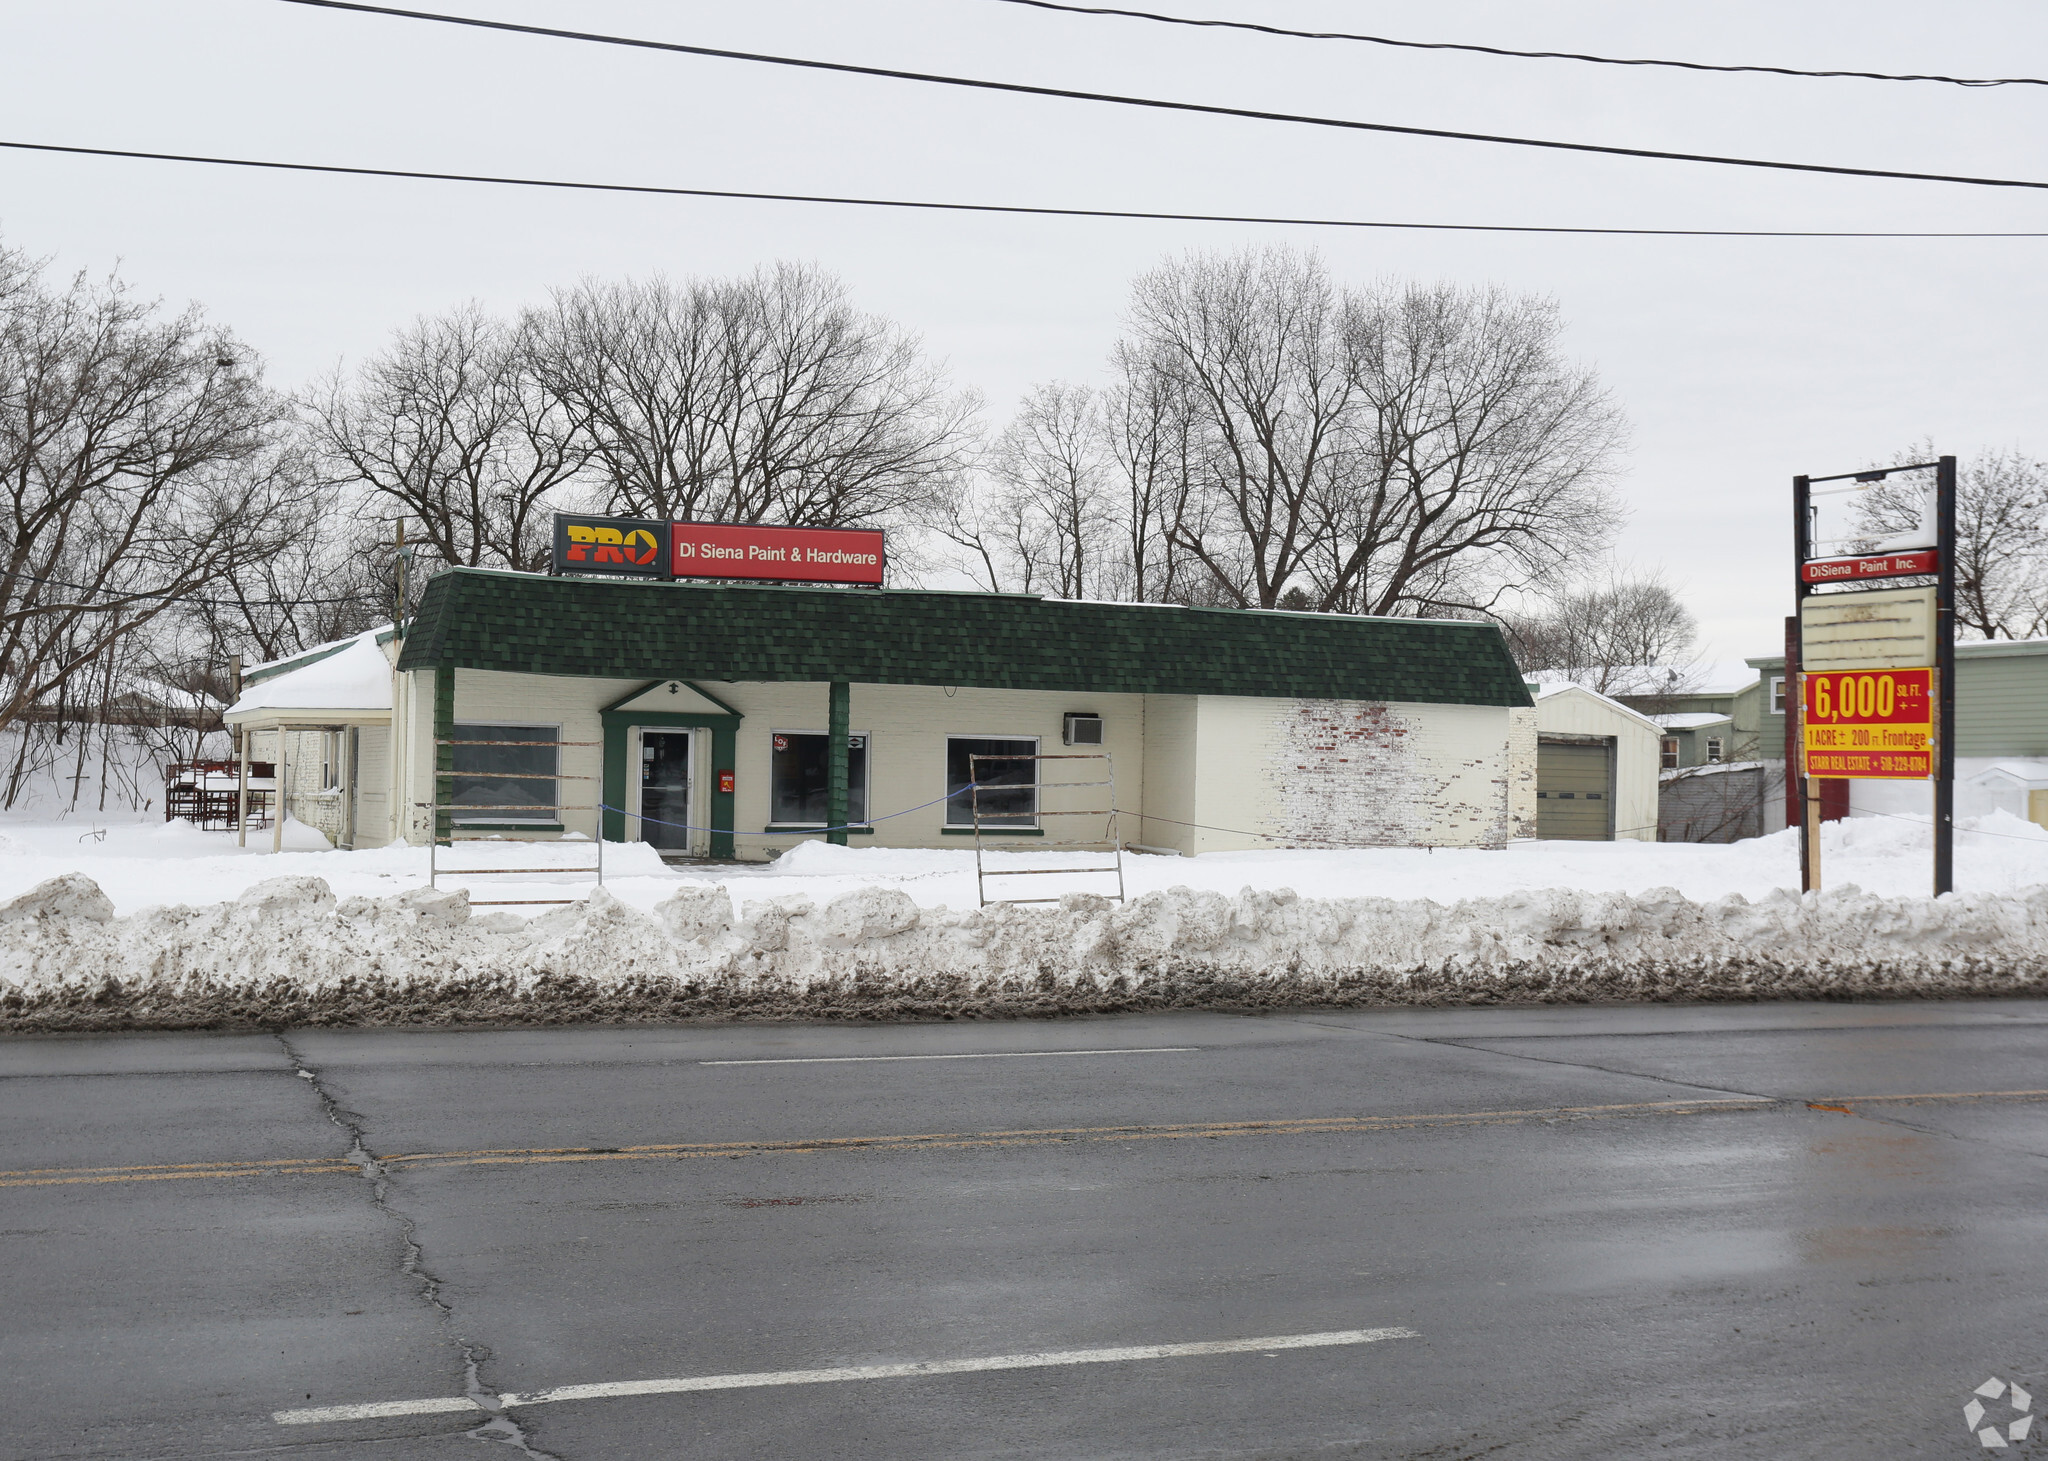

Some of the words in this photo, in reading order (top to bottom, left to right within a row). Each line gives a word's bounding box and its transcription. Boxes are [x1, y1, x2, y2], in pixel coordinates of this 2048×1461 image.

[566, 525, 658, 565] PRO
[679, 542, 696, 558] Di
[700, 543, 744, 560] Siena
[748, 545, 786, 562] Paint
[790, 547, 802, 562] &
[806, 547, 877, 565] Hardware
[1810, 564, 1851, 578] DiSiena
[1859, 560, 1888, 573] Paint
[1895, 558, 1917, 570] Inc.
[1815, 675, 1895, 723] 6,000
[1909, 684, 1921, 697] FT.
[1809, 729, 1813, 746] 1
[1815, 729, 1837, 746] ACRE
[1851, 729, 1870, 746] 200
[1882, 729, 1926, 750] Frontage
[1830, 756, 1847, 770] REAL
[1847, 756, 1871, 771] ESTATE
